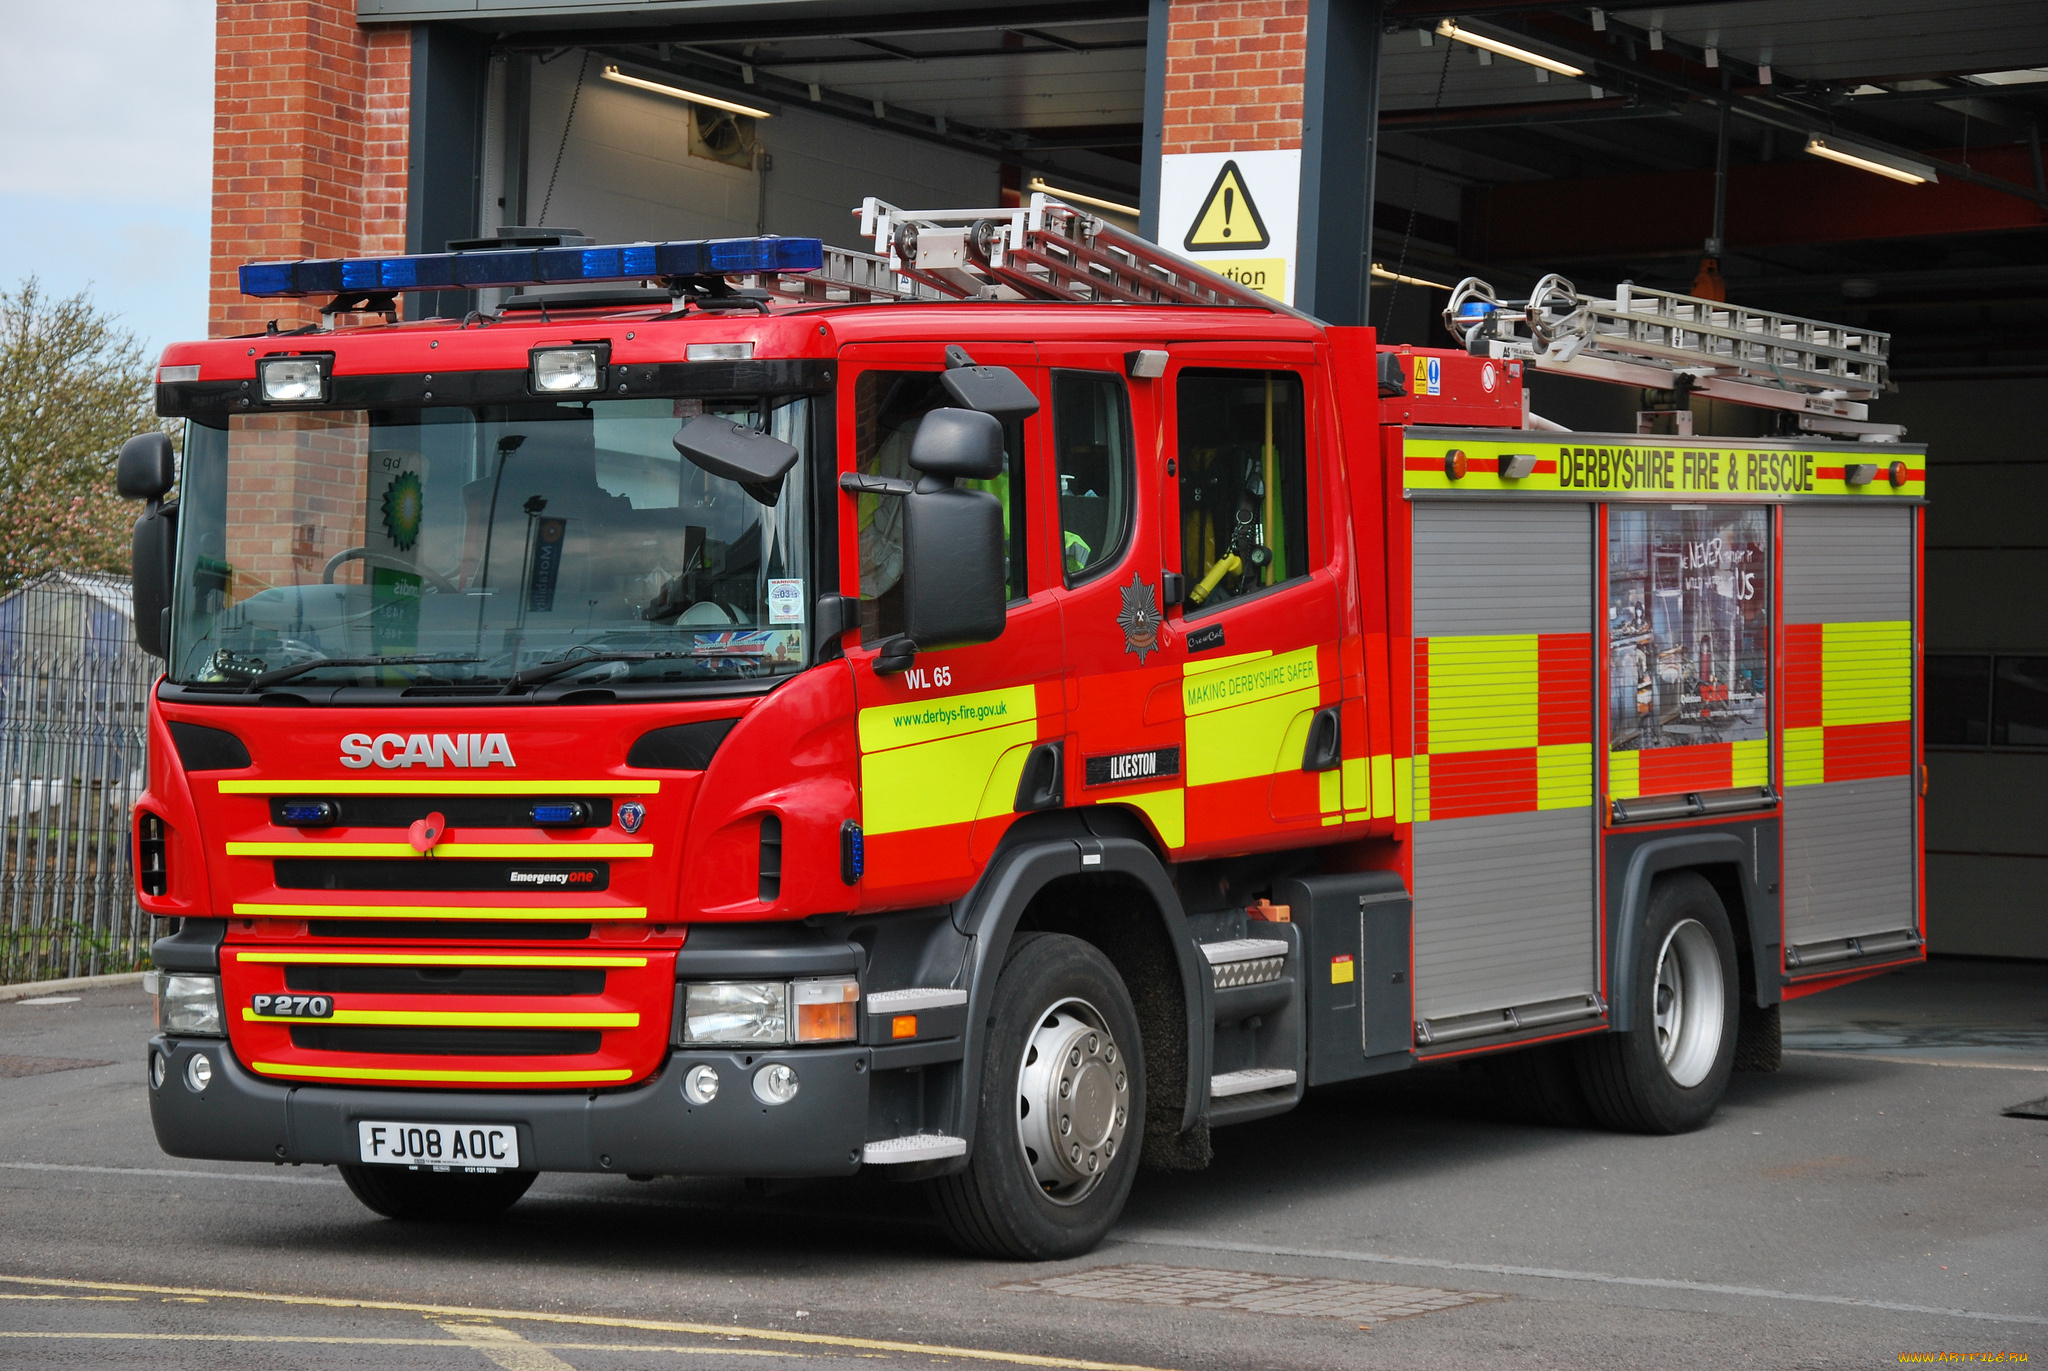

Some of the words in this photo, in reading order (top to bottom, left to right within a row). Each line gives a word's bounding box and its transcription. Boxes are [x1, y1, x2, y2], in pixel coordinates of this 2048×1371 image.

[1222, 267, 1266, 286] tion
[1560, 448, 1675, 489] DERBYSHIRE
[1683, 451, 1720, 490] FIRE
[1727, 454, 1739, 490] &
[1748, 453, 1814, 492] RESCUE
[1689, 538, 1723, 570] NEVER
[780, 590, 790, 598] 03
[1735, 567, 1755, 600] US
[905, 668, 931, 690] WL
[933, 666, 951, 687] 65
[1188, 681, 1226, 706] MAKING
[1228, 667, 1285, 696] DERBYSHIRE
[1287, 660, 1314, 682] SAFER
[1700, 684, 1728, 702] YOUR
[893, 701, 1007, 727] www.derbys-fire.gov.uk
[339, 732, 517, 769] SCANIA
[1110, 752, 1156, 780] ILKESTON
[510, 872, 568, 884] Emergency
[569, 872, 594, 882] one
[254, 995, 271, 1014] P
[275, 996, 328, 1016] 270
[371, 1127, 442, 1158] FJ08
[453, 1130, 506, 1160] AOC
